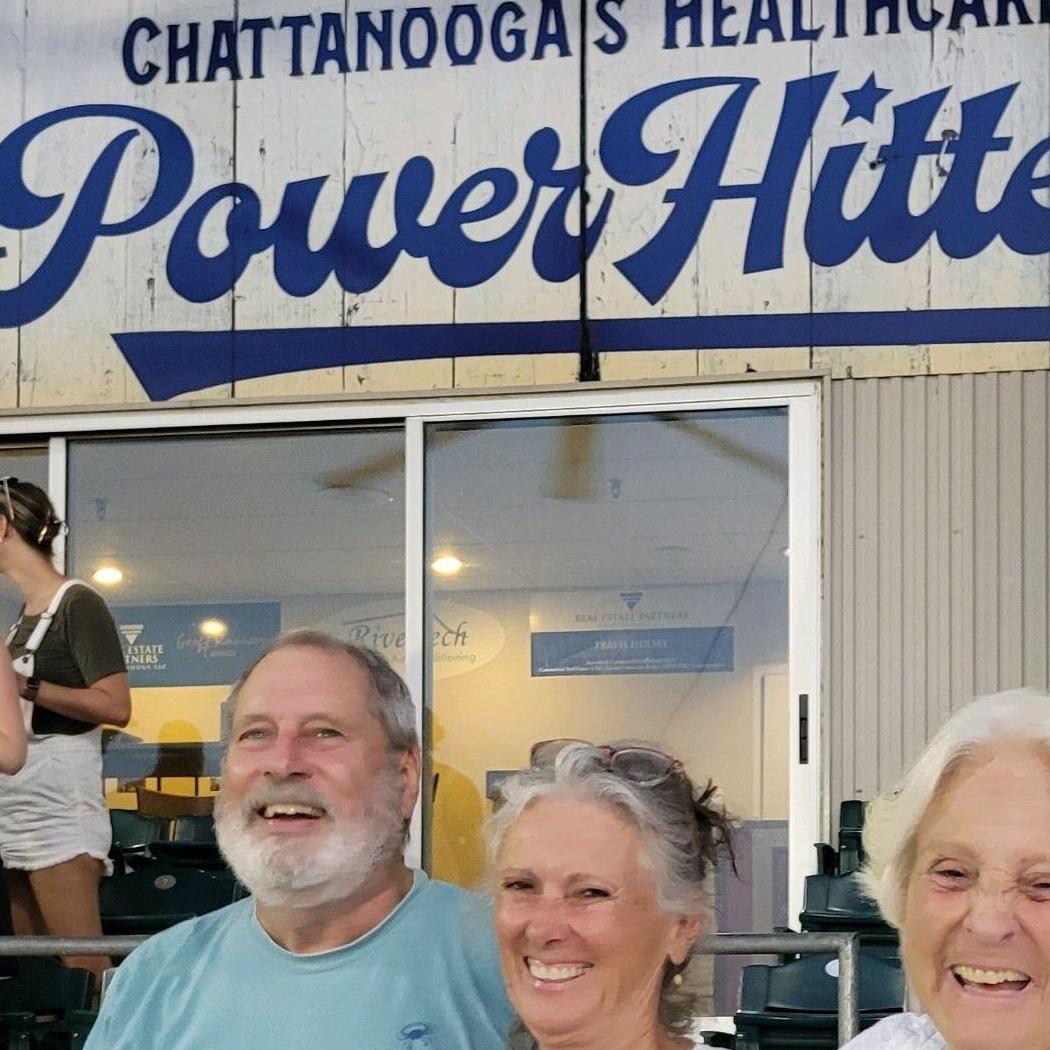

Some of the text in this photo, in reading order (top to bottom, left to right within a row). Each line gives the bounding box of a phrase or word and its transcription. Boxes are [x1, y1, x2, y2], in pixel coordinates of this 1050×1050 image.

[122, 0, 628, 85] CHATTANOOGAS
[0, 104, 613, 328] Power
[125, 655, 159, 664] TNERS
